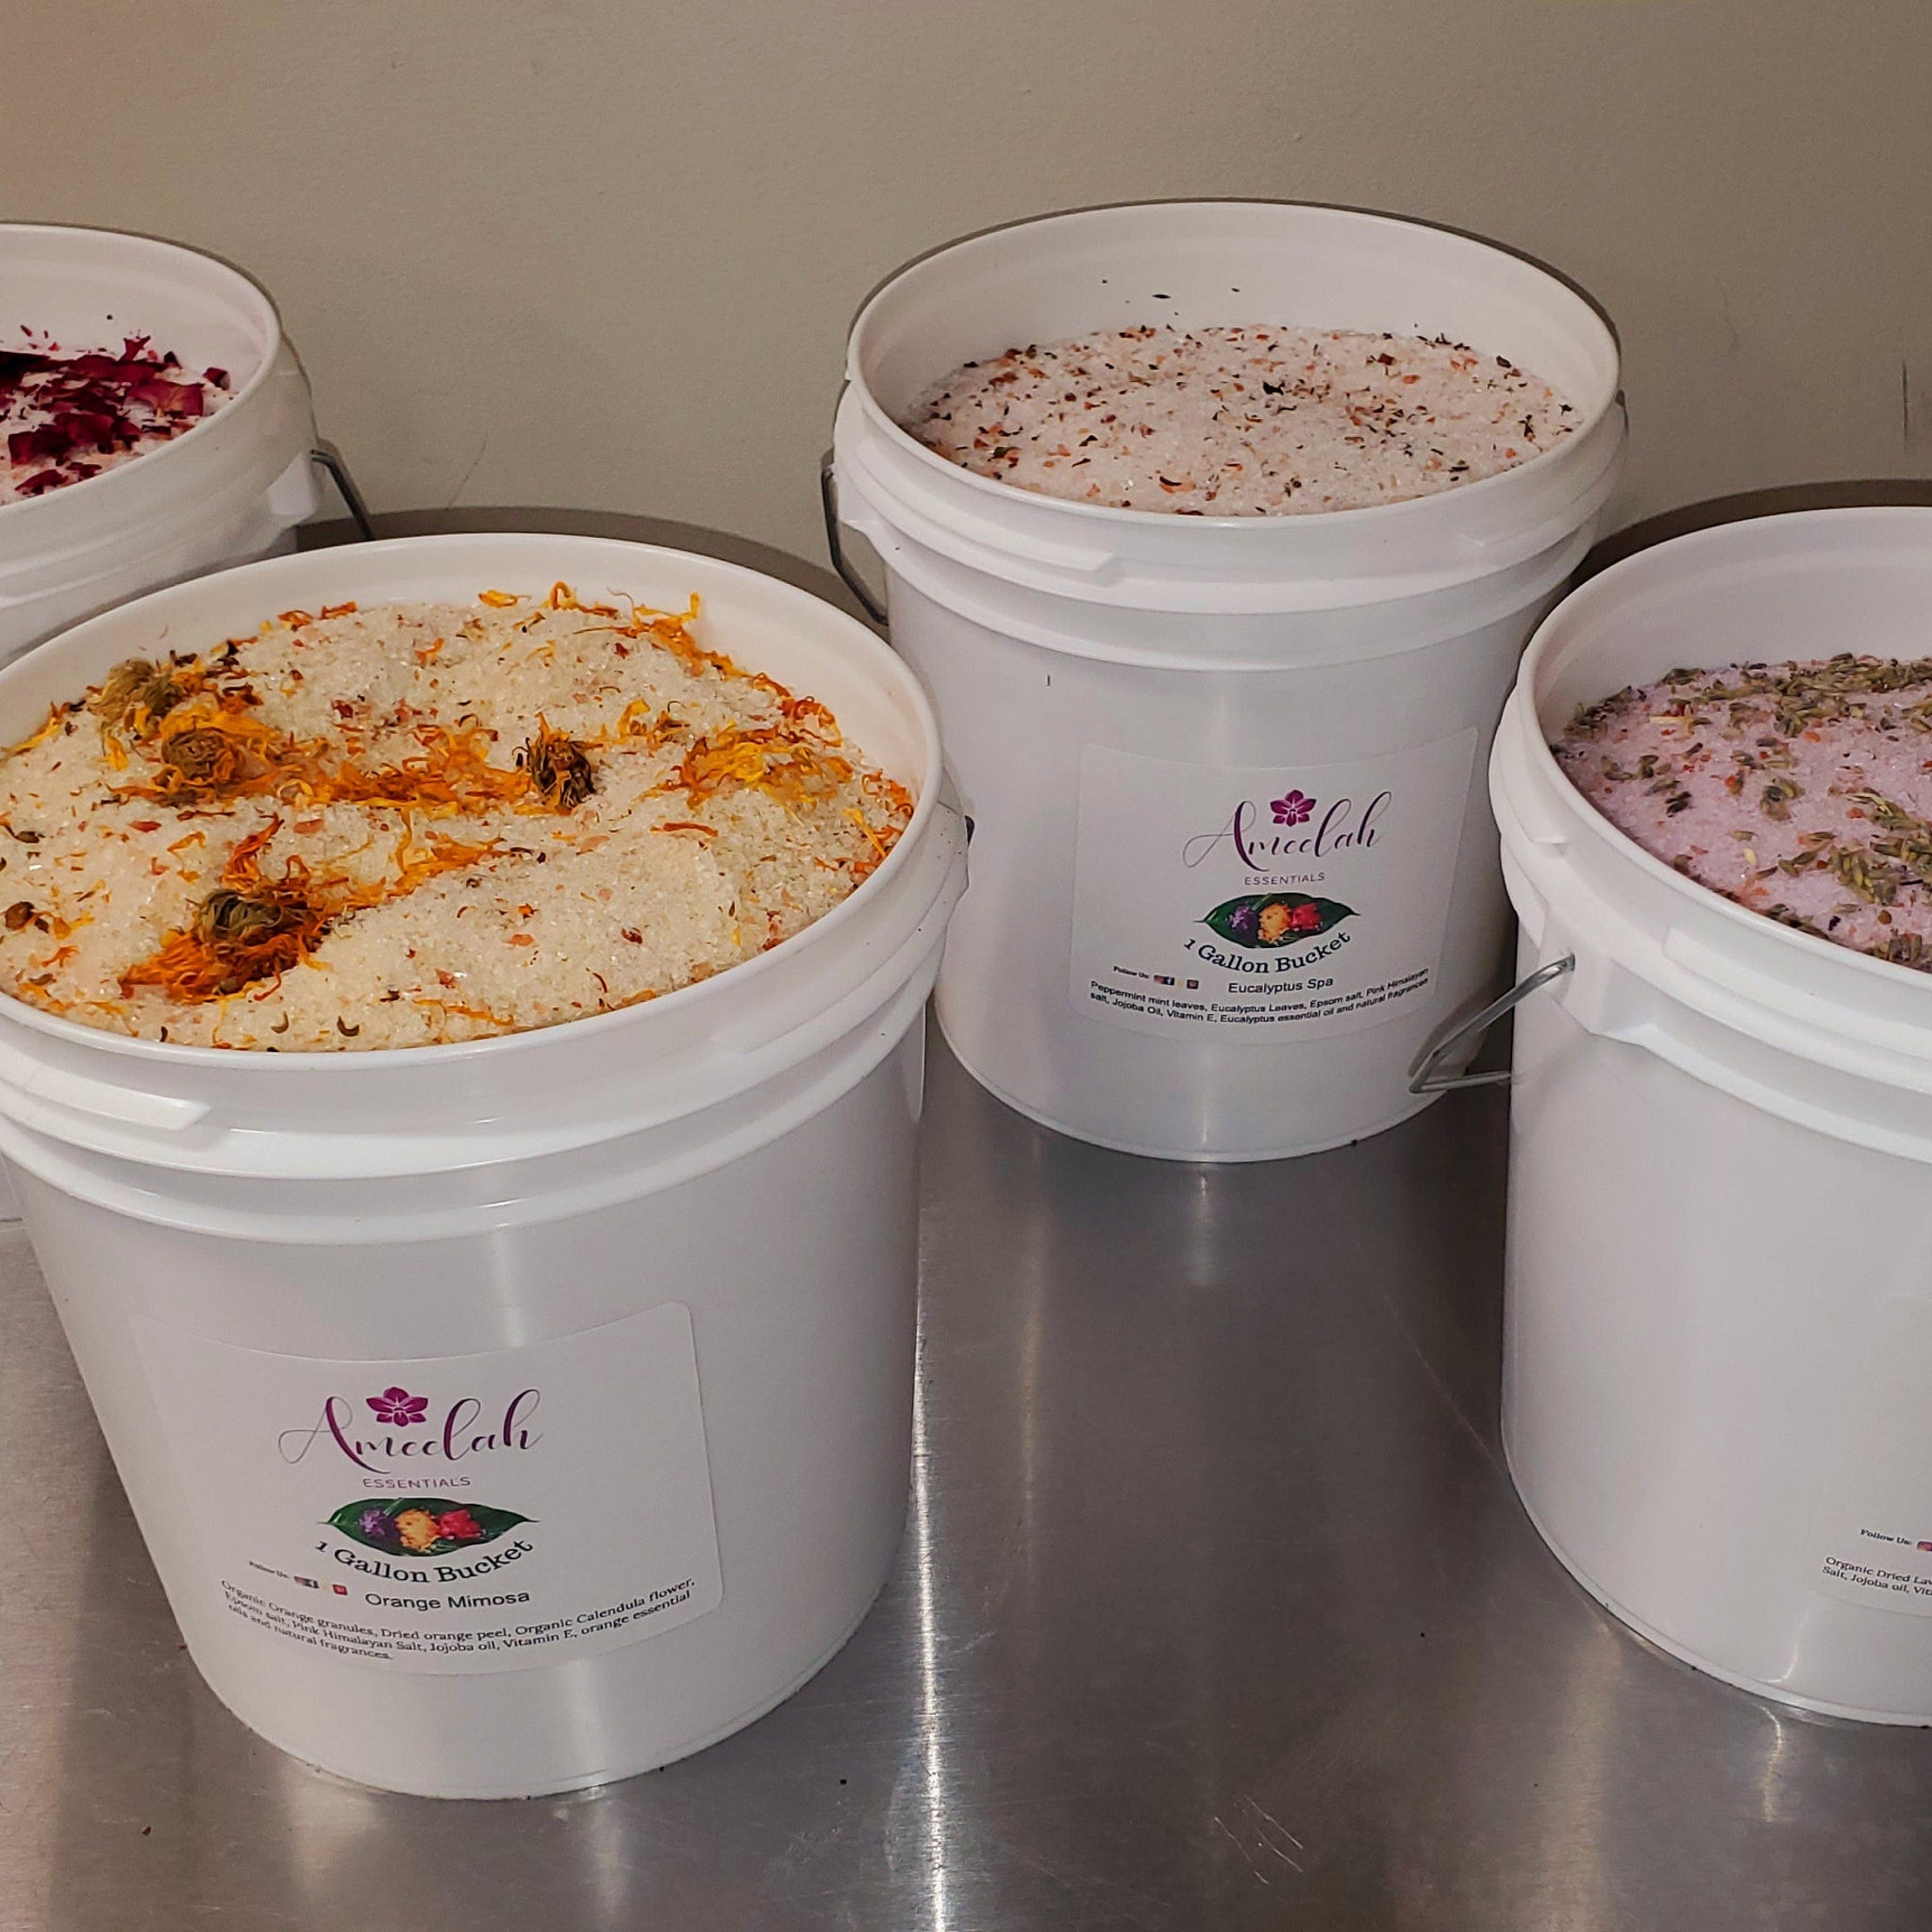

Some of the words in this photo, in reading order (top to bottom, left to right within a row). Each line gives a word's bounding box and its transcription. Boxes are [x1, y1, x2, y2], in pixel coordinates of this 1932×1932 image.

[1244, 872, 1325, 887] ESSENTIALS
[1184, 938, 1196, 950] 1
[1197, 943, 1270, 974] Gallon
[1274, 930, 1352, 973] Bucket
[1091, 980, 1146, 1002] Peppermint
[1148, 995, 1170, 1007] mint
[1172, 1000, 1208, 1012] leaves,
[1211, 1004, 1266, 1014] Eucalyptus
[1269, 1003, 1307, 1012] Leaves,
[1309, 996, 1343, 1008] Epsom
[1366, 984, 1385, 996] Pink
[1387, 968, 1429, 990] Himalayan
[1228, 982, 1303, 995] Eucalyptus
[1307, 977, 1334, 991] Spa
[1091, 992, 1109, 1005] salt,
[1112, 998, 1144, 1012] Jojoba
[1167, 1009, 1204, 1022] Vitamin
[1220, 1014, 1275, 1024] Eucalyptus
[1277, 1009, 1321, 1022] essential
[1323, 1008, 1334, 1017] oil
[1336, 1004, 1354, 1014] and
[1356, 993, 1386, 1009] natural
[362, 1475, 471, 1489] ESSENTIALS
[1860, 1528, 1894, 1541] Follow
[315, 1540, 328, 1553] 1
[333, 1548, 431, 1583] Gallon
[434, 1540, 534, 1583] Bucket
[1825, 1557, 1874, 1574] Organic
[1876, 1569, 1910, 1582] Dried
[1822, 1566, 1848, 1581] Salt,
[1850, 1574, 1889, 1589] Jojoba
[1891, 1584, 1909, 1593] oil,
[221, 1579, 266, 1606] Organic
[268, 1602, 314, 1624] Orange
[317, 1618, 377, 1638] granules,
[381, 1628, 420, 1641] Dried
[424, 1631, 473, 1642] orange
[476, 1627, 511, 1641] peel,
[515, 1619, 574, 1635] Organic
[576, 1597, 645, 1624] Calendula
[648, 1578, 695, 1602] flower,
[365, 1592, 441, 1611] Orange
[447, 1591, 530, 1608] Mimosa
[225, 1591, 263, 1616] Epsom
[291, 1621, 319, 1635] Pink
[323, 1629, 392, 1650] Himalayan
[396, 1641, 427, 1653] Salt,
[430, 1642, 475, 1654] Jojoba
[477, 1641, 500, 1651] oil,
[503, 1632, 559, 1649] Vitamin
[563, 1629, 577, 1639] E,
[581, 1616, 629, 1635] orange
[632, 1590, 691, 1620] essential
[227, 1604, 248, 1619] oils
[250, 1616, 271, 1629] and
[274, 1624, 317, 1645] natural
